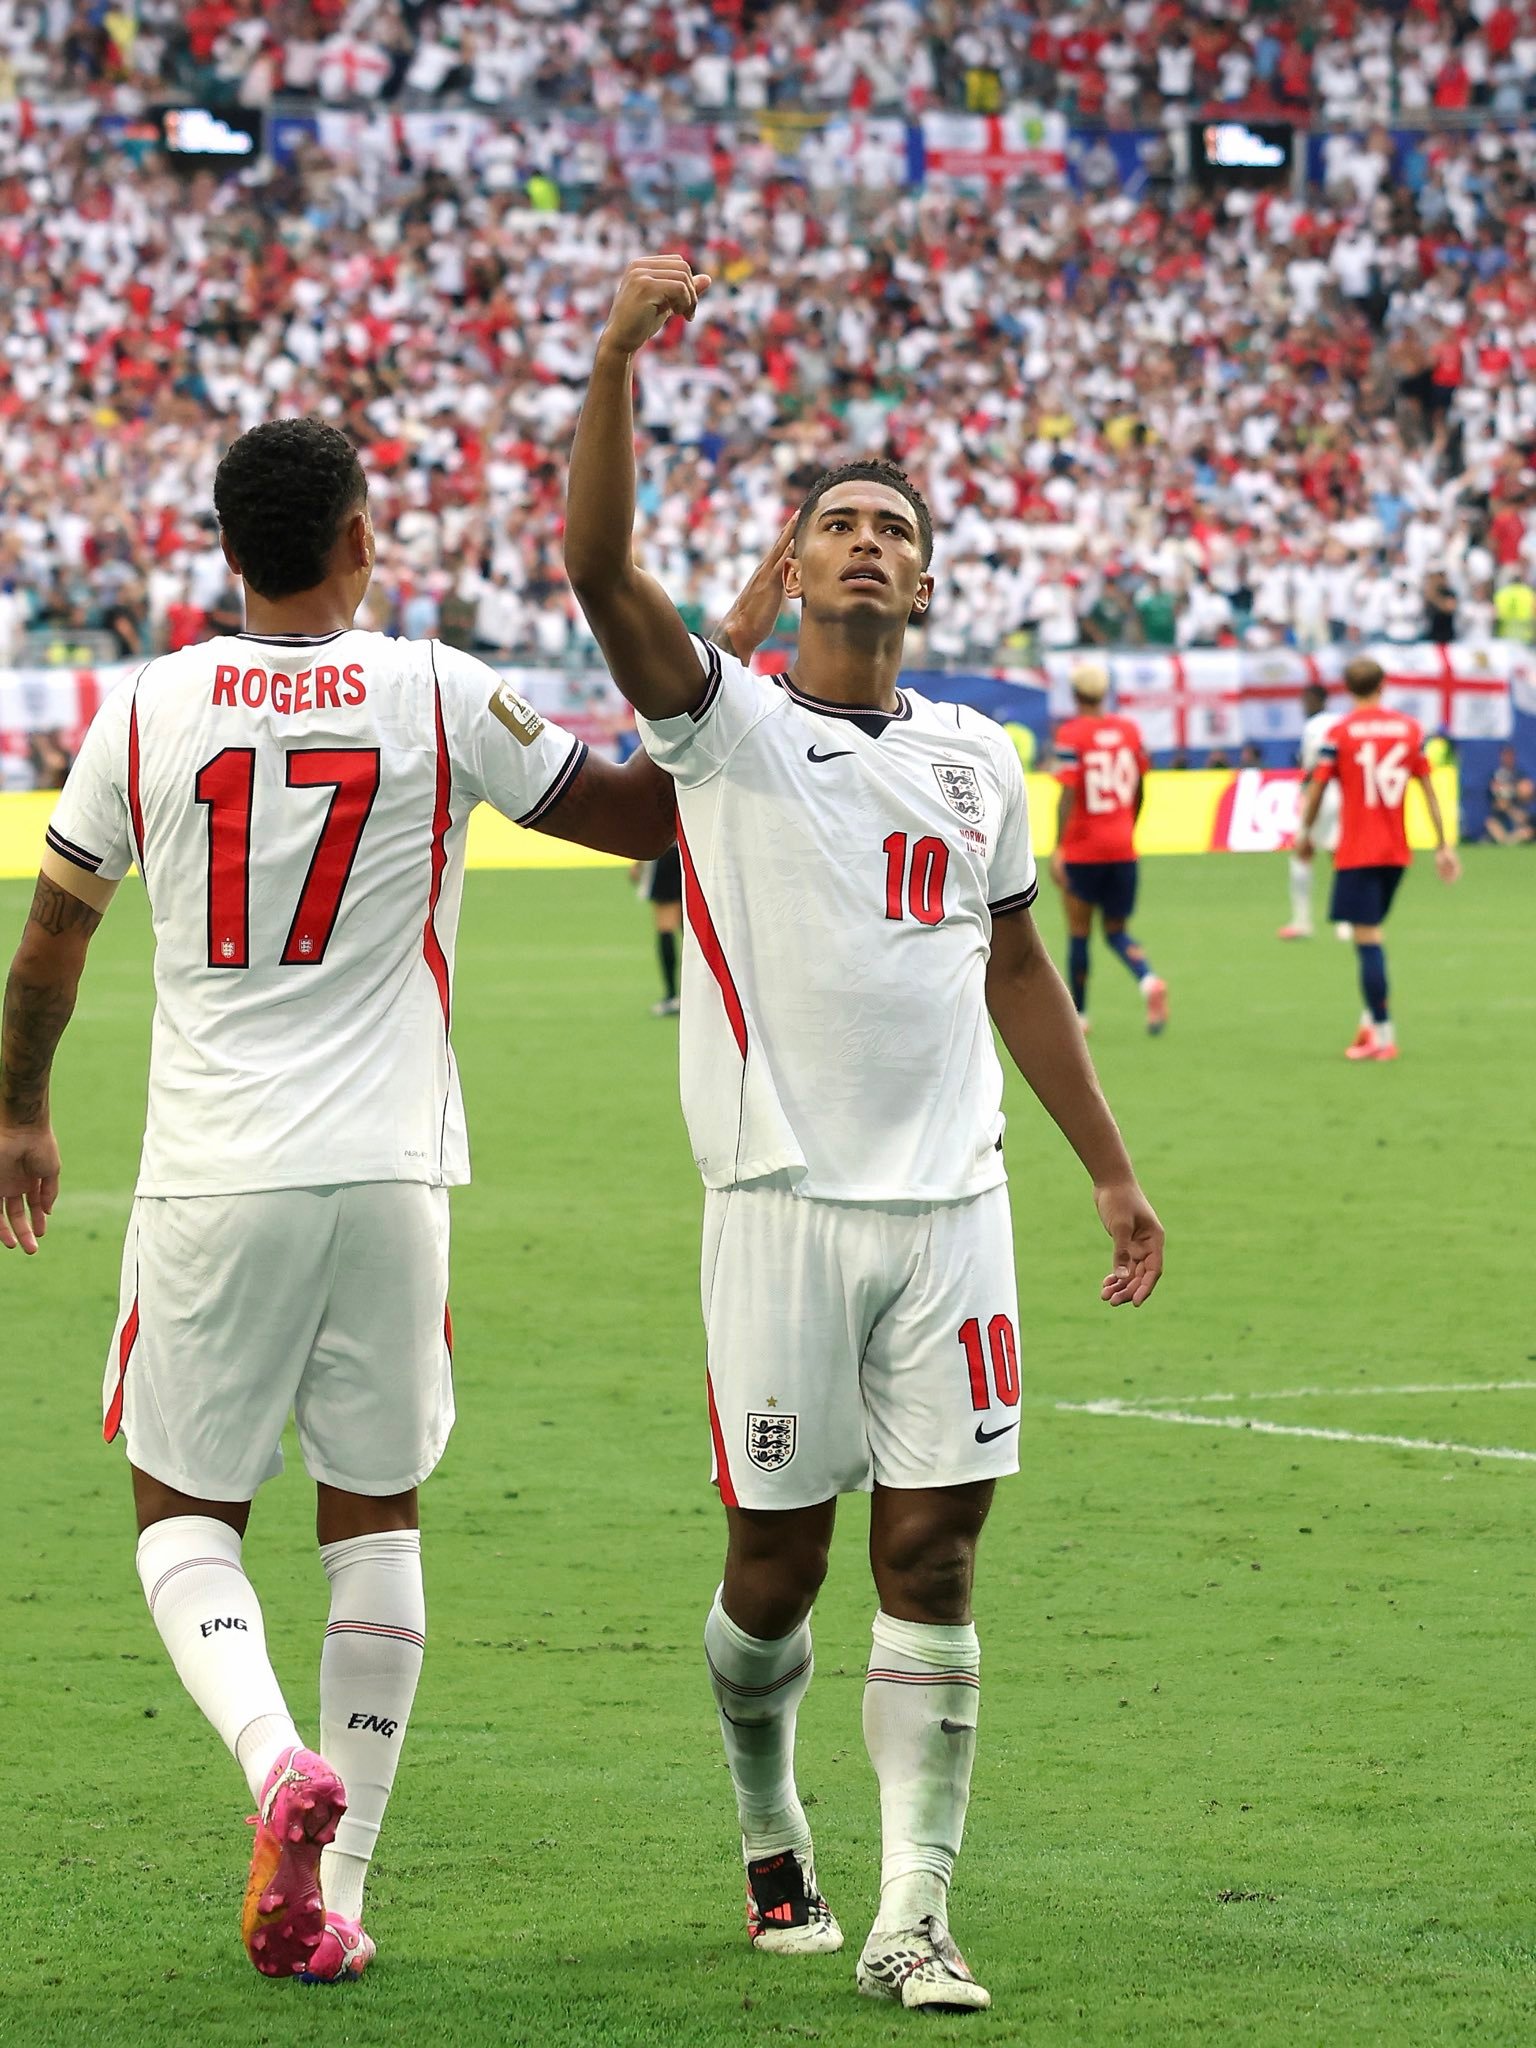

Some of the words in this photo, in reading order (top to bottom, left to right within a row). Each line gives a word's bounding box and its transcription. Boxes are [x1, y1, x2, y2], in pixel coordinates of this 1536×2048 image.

[211, 663, 366, 715] ROGERS
[1353, 740, 1408, 809] 16
[195, 747, 381, 969] 17
[882, 831, 950, 926] 10
[957, 1313, 1020, 1411] 10
[200, 1617, 248, 1638] ENG
[347, 1712, 398, 1738] ENG
